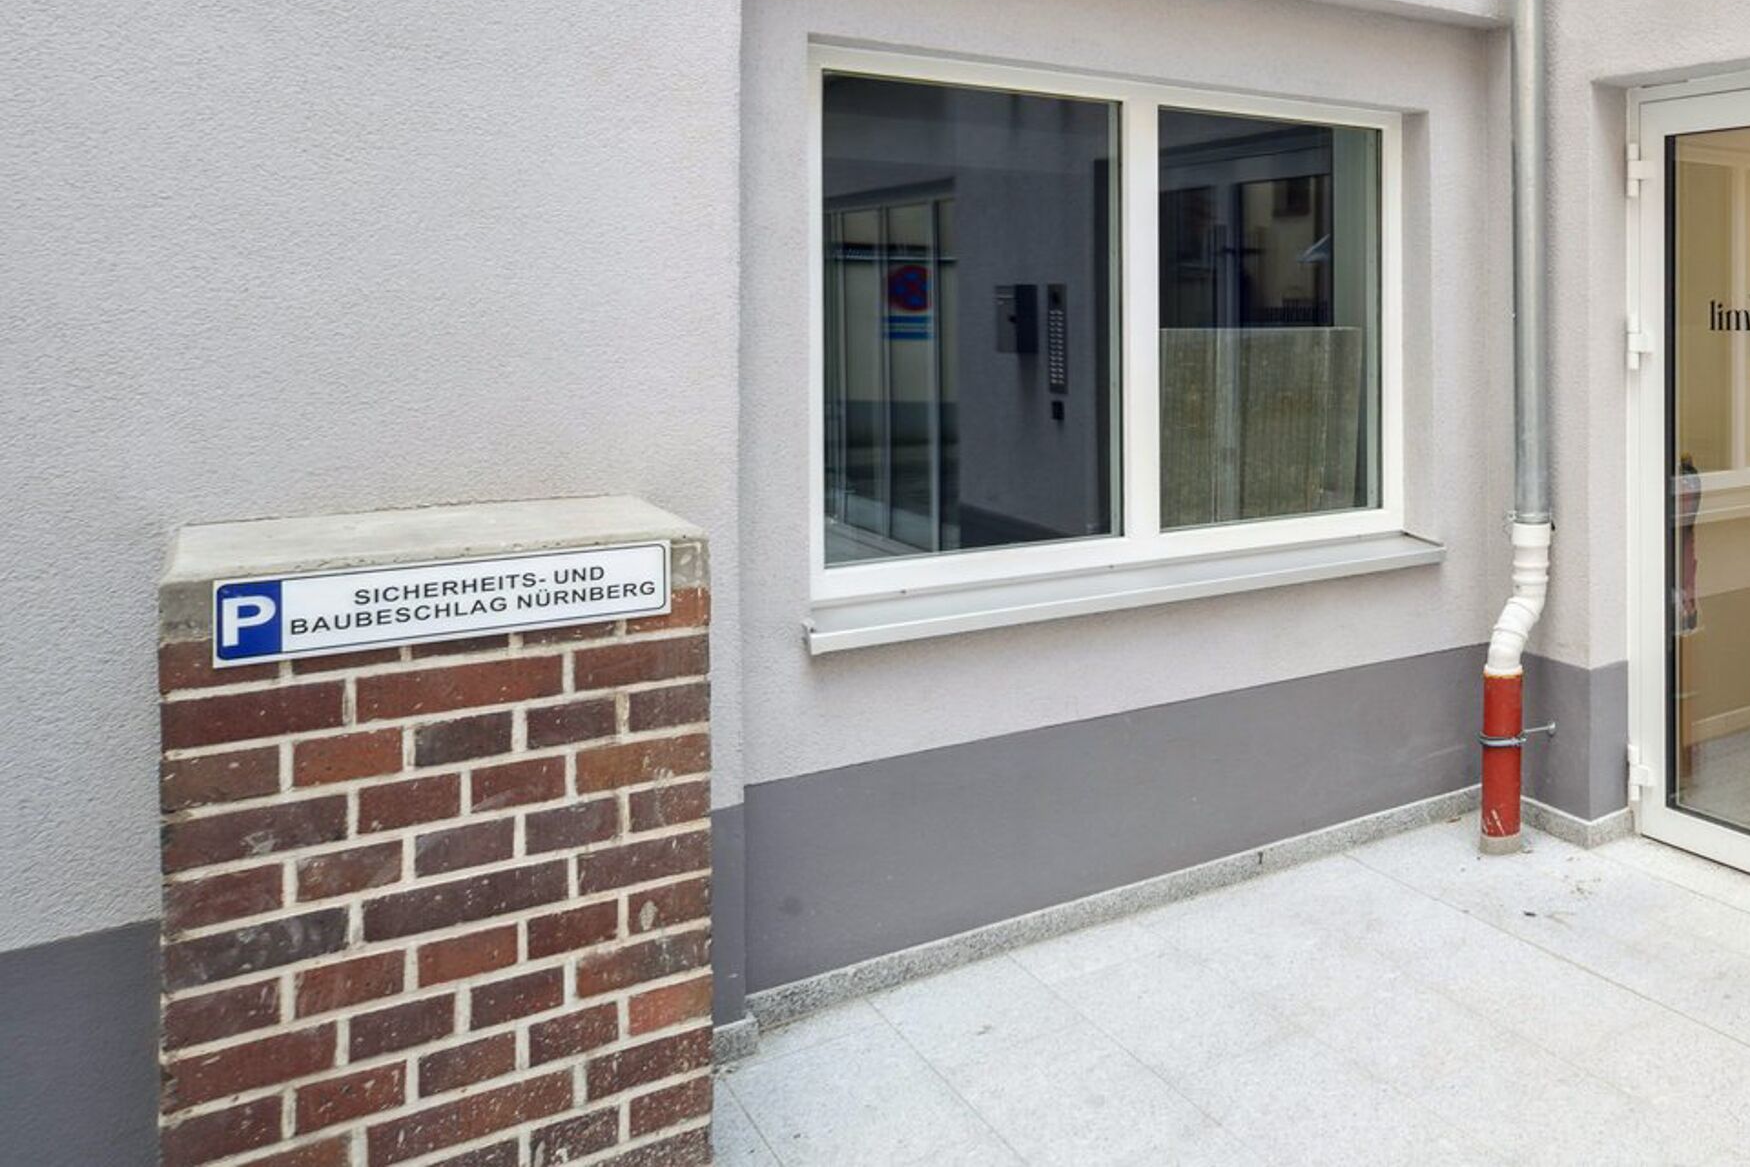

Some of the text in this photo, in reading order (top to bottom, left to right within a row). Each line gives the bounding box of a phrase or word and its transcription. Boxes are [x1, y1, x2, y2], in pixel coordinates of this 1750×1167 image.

[290, 580, 656, 635] BAUBESCHLAG NÜRNBERG
[353, 566, 605, 606] SICHERHEITS- UND
[221, 595, 277, 648] P
